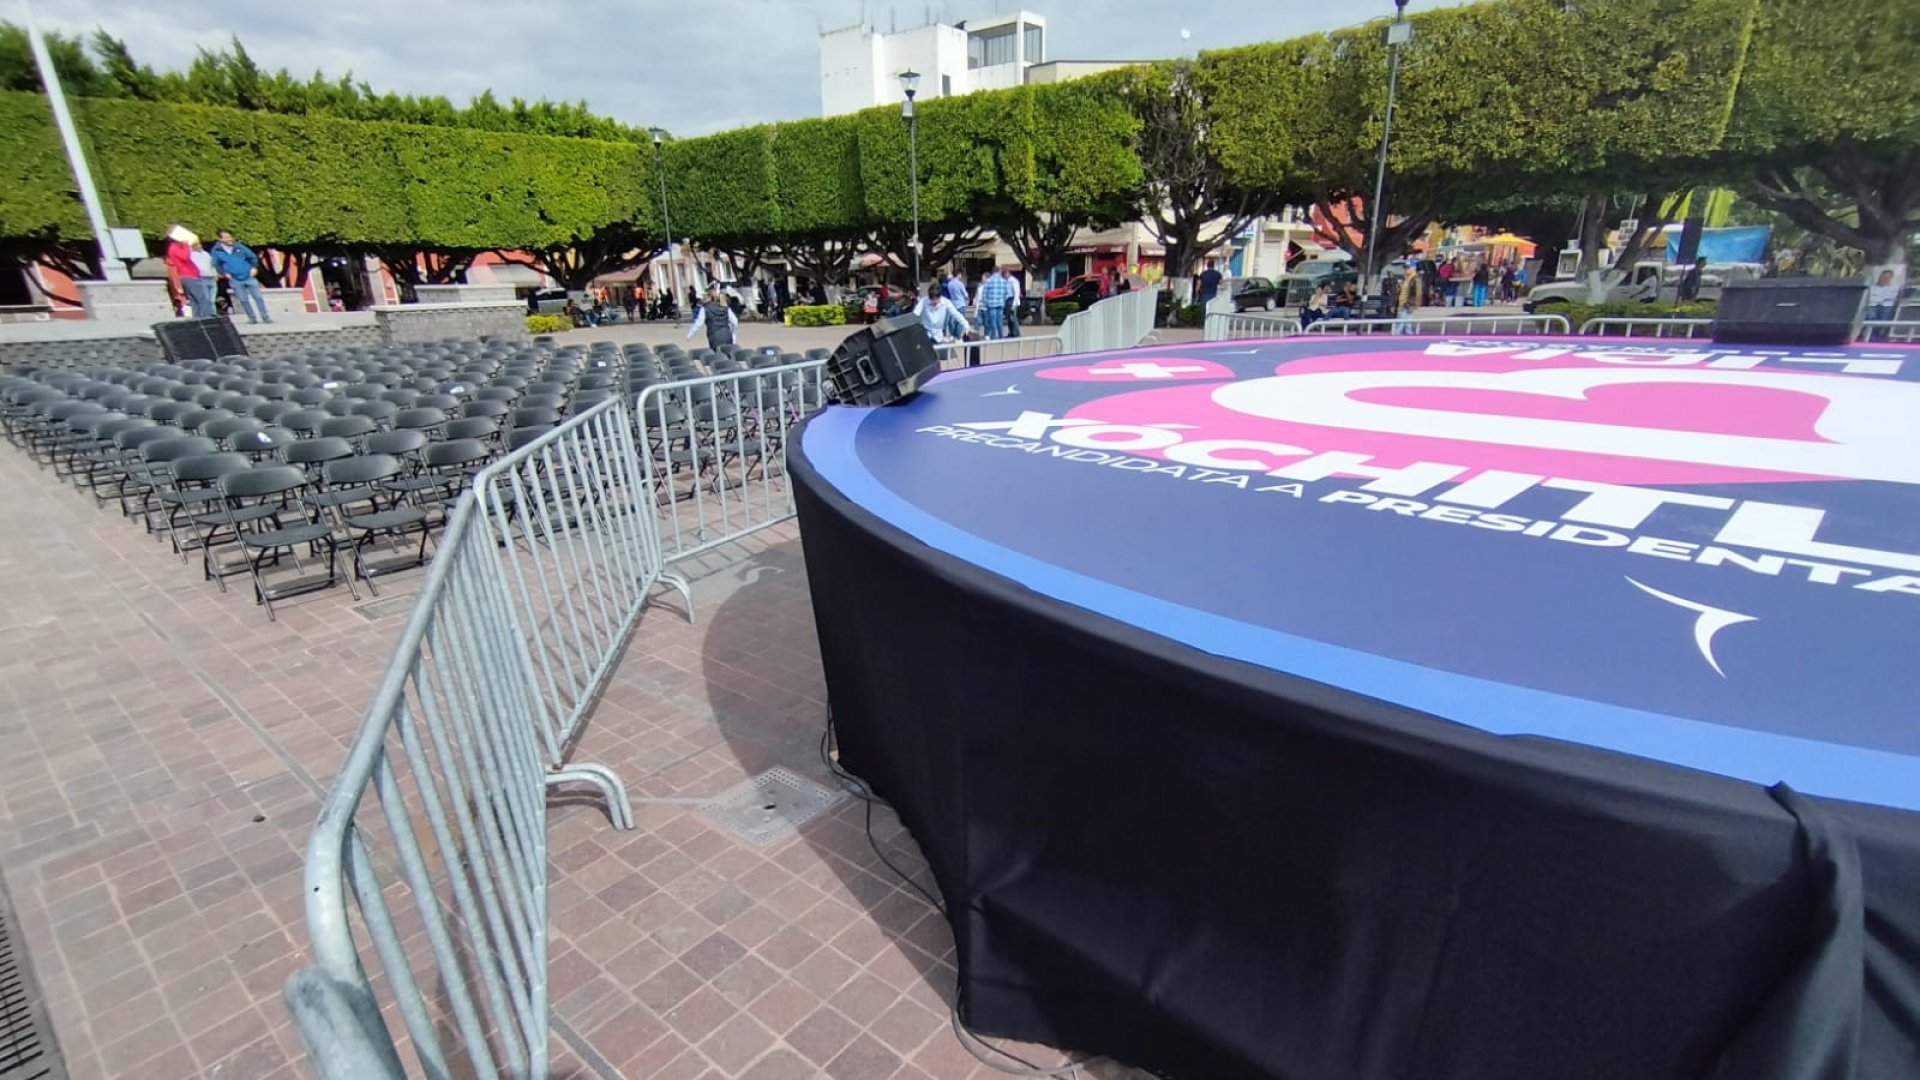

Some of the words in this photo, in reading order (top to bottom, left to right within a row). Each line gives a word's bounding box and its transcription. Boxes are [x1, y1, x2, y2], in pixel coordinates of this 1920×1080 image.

[916, 425, 1249, 490] PRECANDIDATA
[1257, 480, 1304, 498] A
[1318, 489, 1920, 595] PRESIDENTA
[953, 410, 1920, 571] XÓCHITL
